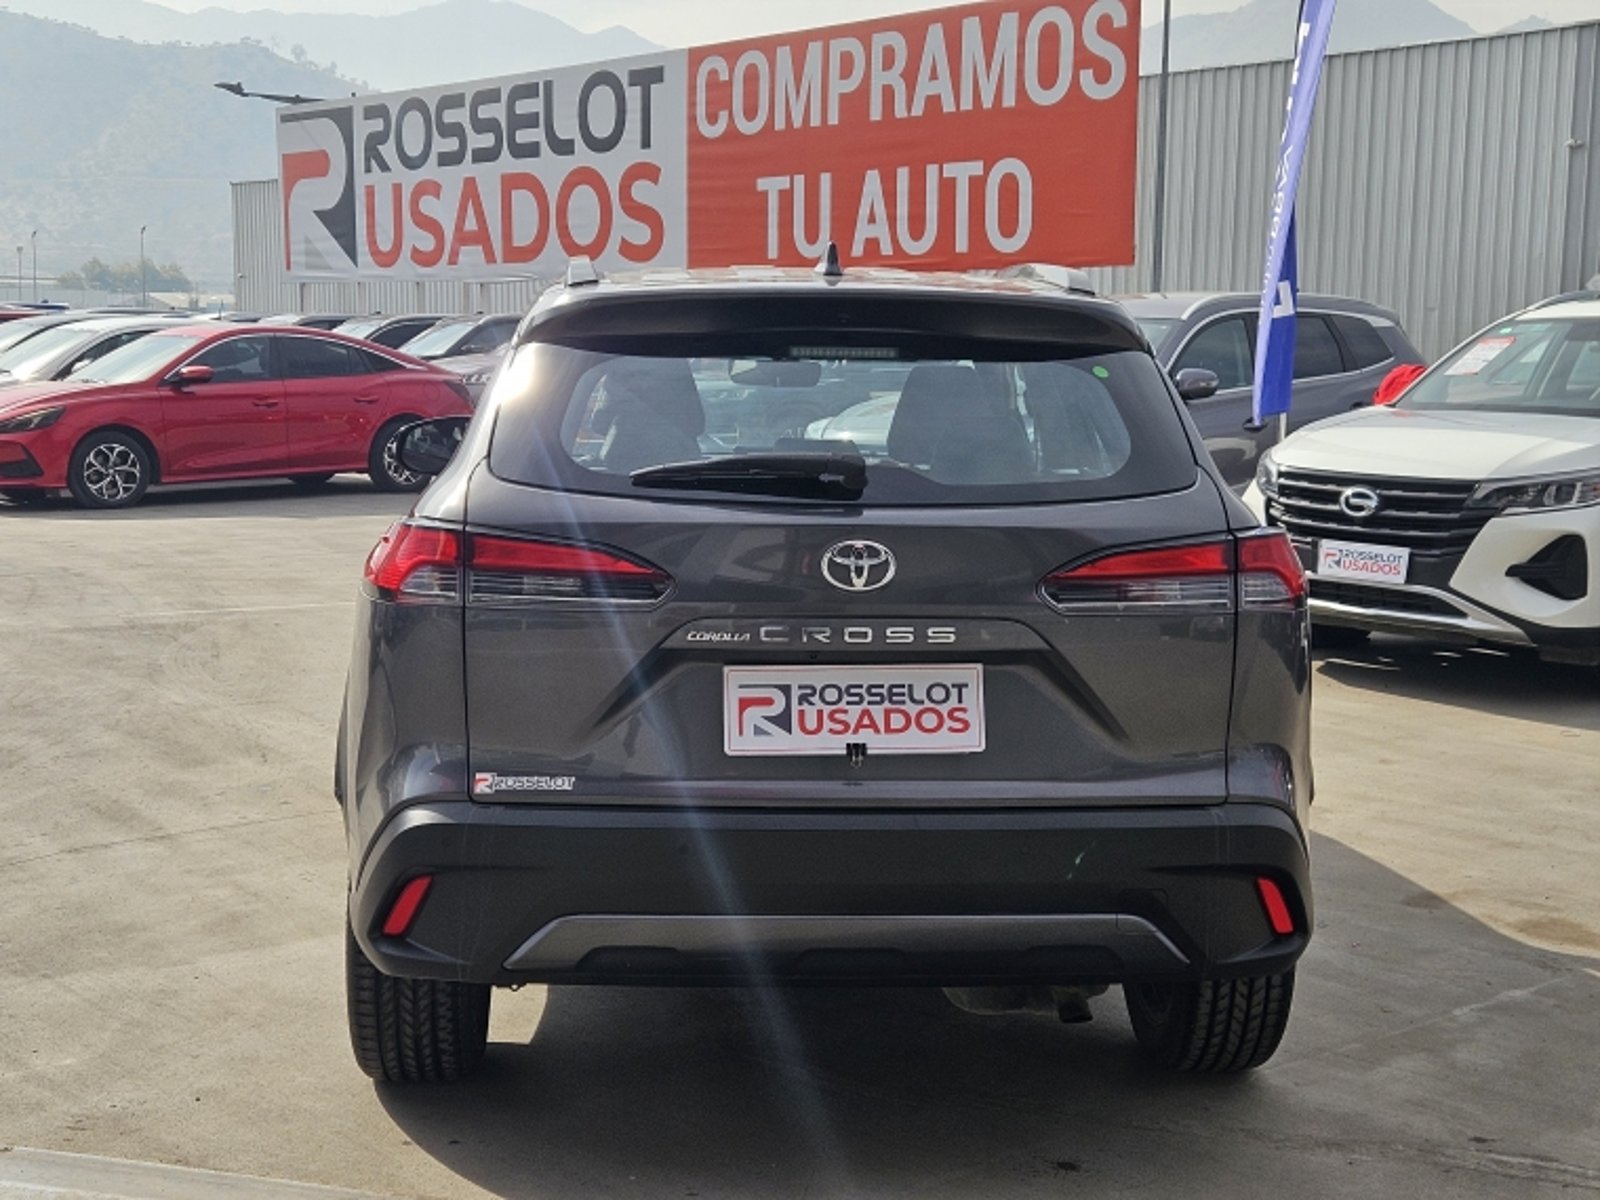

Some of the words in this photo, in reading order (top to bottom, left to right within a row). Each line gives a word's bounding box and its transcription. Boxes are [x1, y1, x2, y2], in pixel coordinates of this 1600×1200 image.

[696, 0, 1127, 138] COMPRAMOS
[364, 65, 664, 174] ROSSELOT
[364, 161, 664, 268] USADOS
[756, 172, 832, 260] TU
[851, 157, 1032, 258] AUTO
[1341, 548, 1403, 563] ROSSELOT
[1342, 558, 1402, 576] USADOS
[686, 630, 750, 644] COROLLA
[759, 626, 957, 643] CROSS
[797, 681, 970, 706] ROSSELOT
[797, 706, 972, 736] USADOS
[494, 776, 576, 790] ROSSELOT
